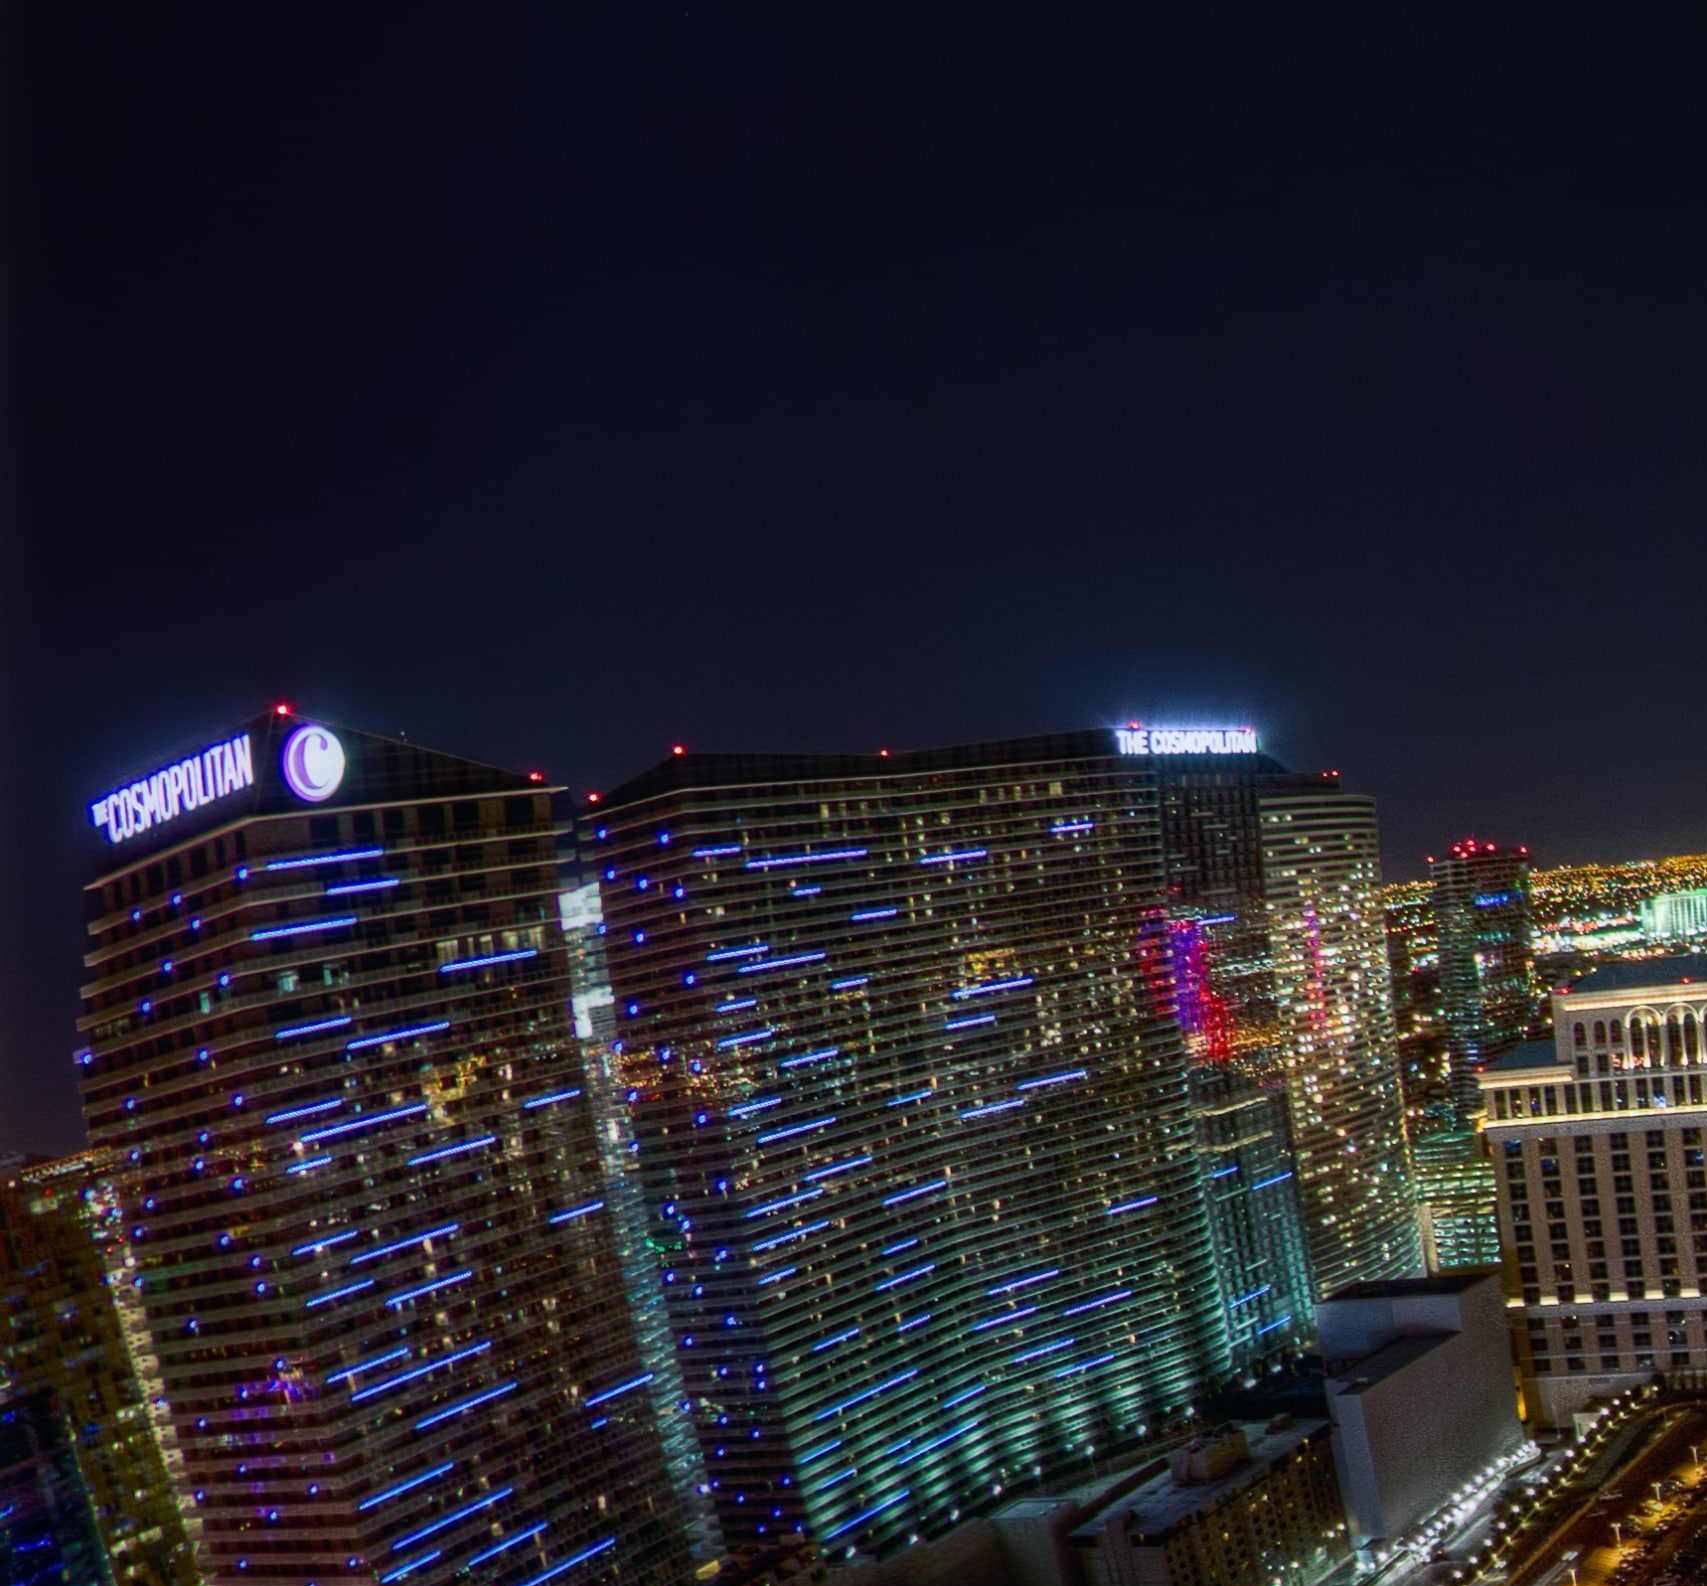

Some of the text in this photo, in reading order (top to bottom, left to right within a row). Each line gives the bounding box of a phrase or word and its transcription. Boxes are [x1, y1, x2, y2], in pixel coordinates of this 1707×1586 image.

[1115, 730, 1257, 754] THE COSMOPOLITAN
[107, 734, 253, 843] COSMOPOLITAN
